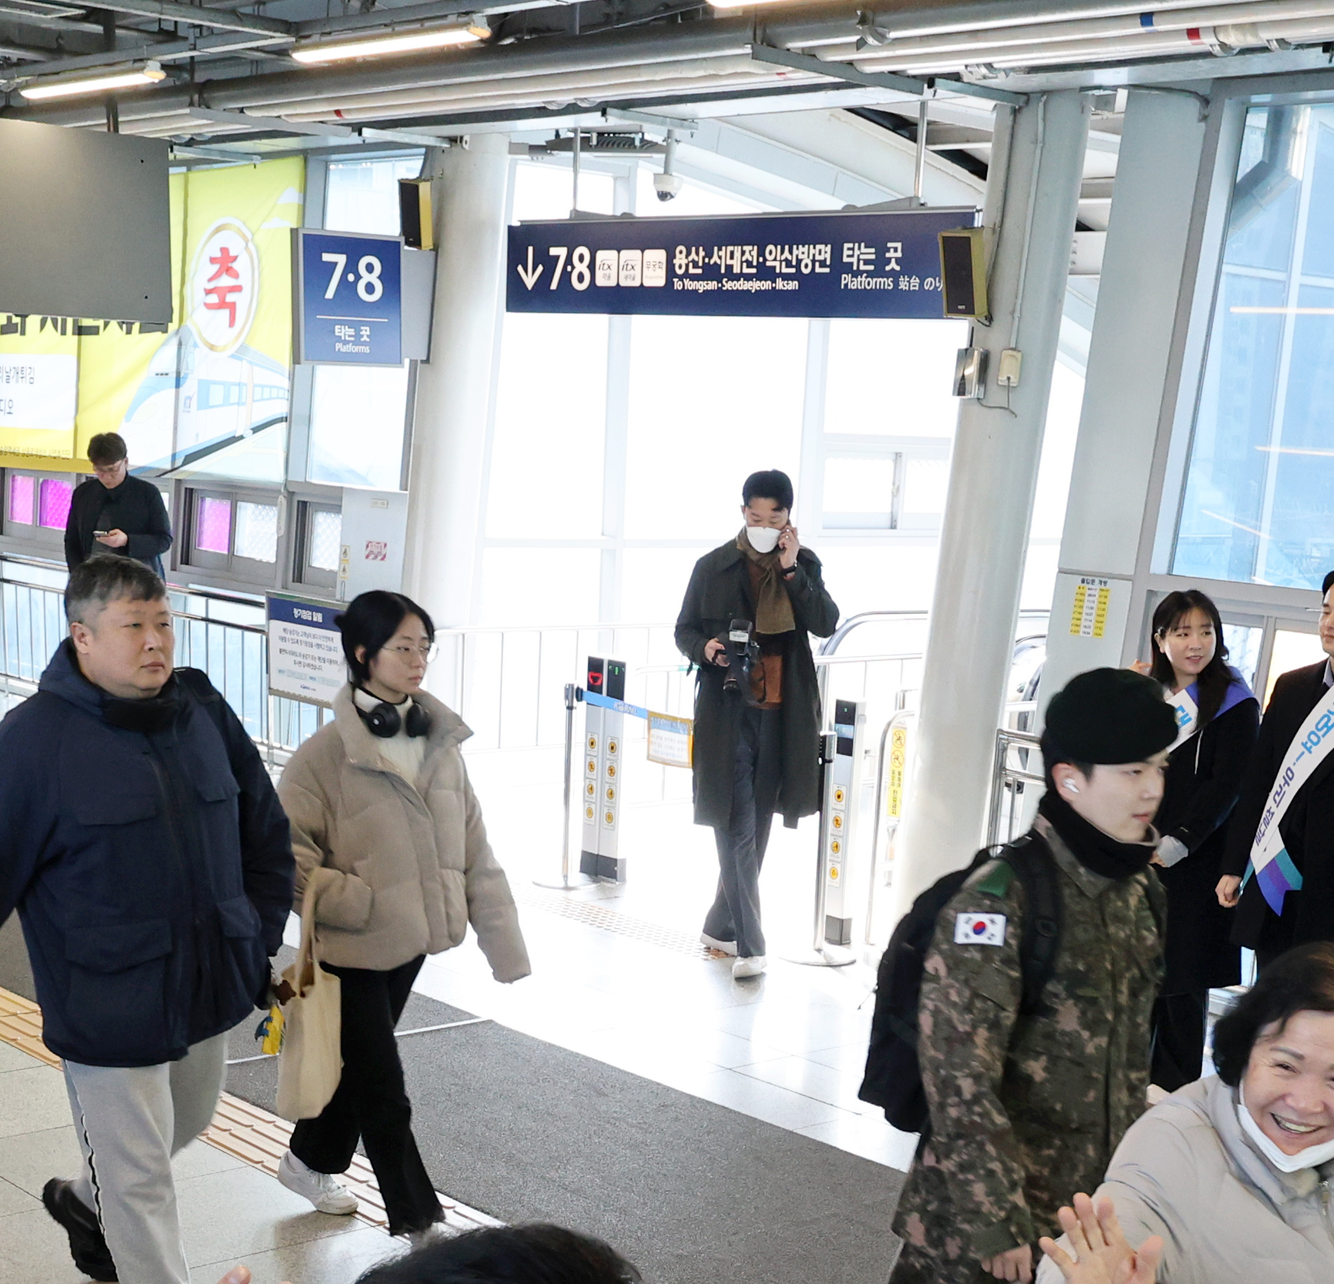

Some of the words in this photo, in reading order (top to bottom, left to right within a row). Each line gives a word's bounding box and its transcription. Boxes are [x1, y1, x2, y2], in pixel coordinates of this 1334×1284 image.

[673, 243, 832, 275] 용산·서대전·익산방면
[842, 242, 875, 271] 타는
[885, 242, 903, 271] 곳
[203, 246, 245, 328] 축
[673, 278, 683, 290] To
[841, 273, 893, 290] Platforms
[334, 325, 355, 341] 타는
[360, 326, 370, 342] 곳
[335, 342, 370, 354] Platforms
